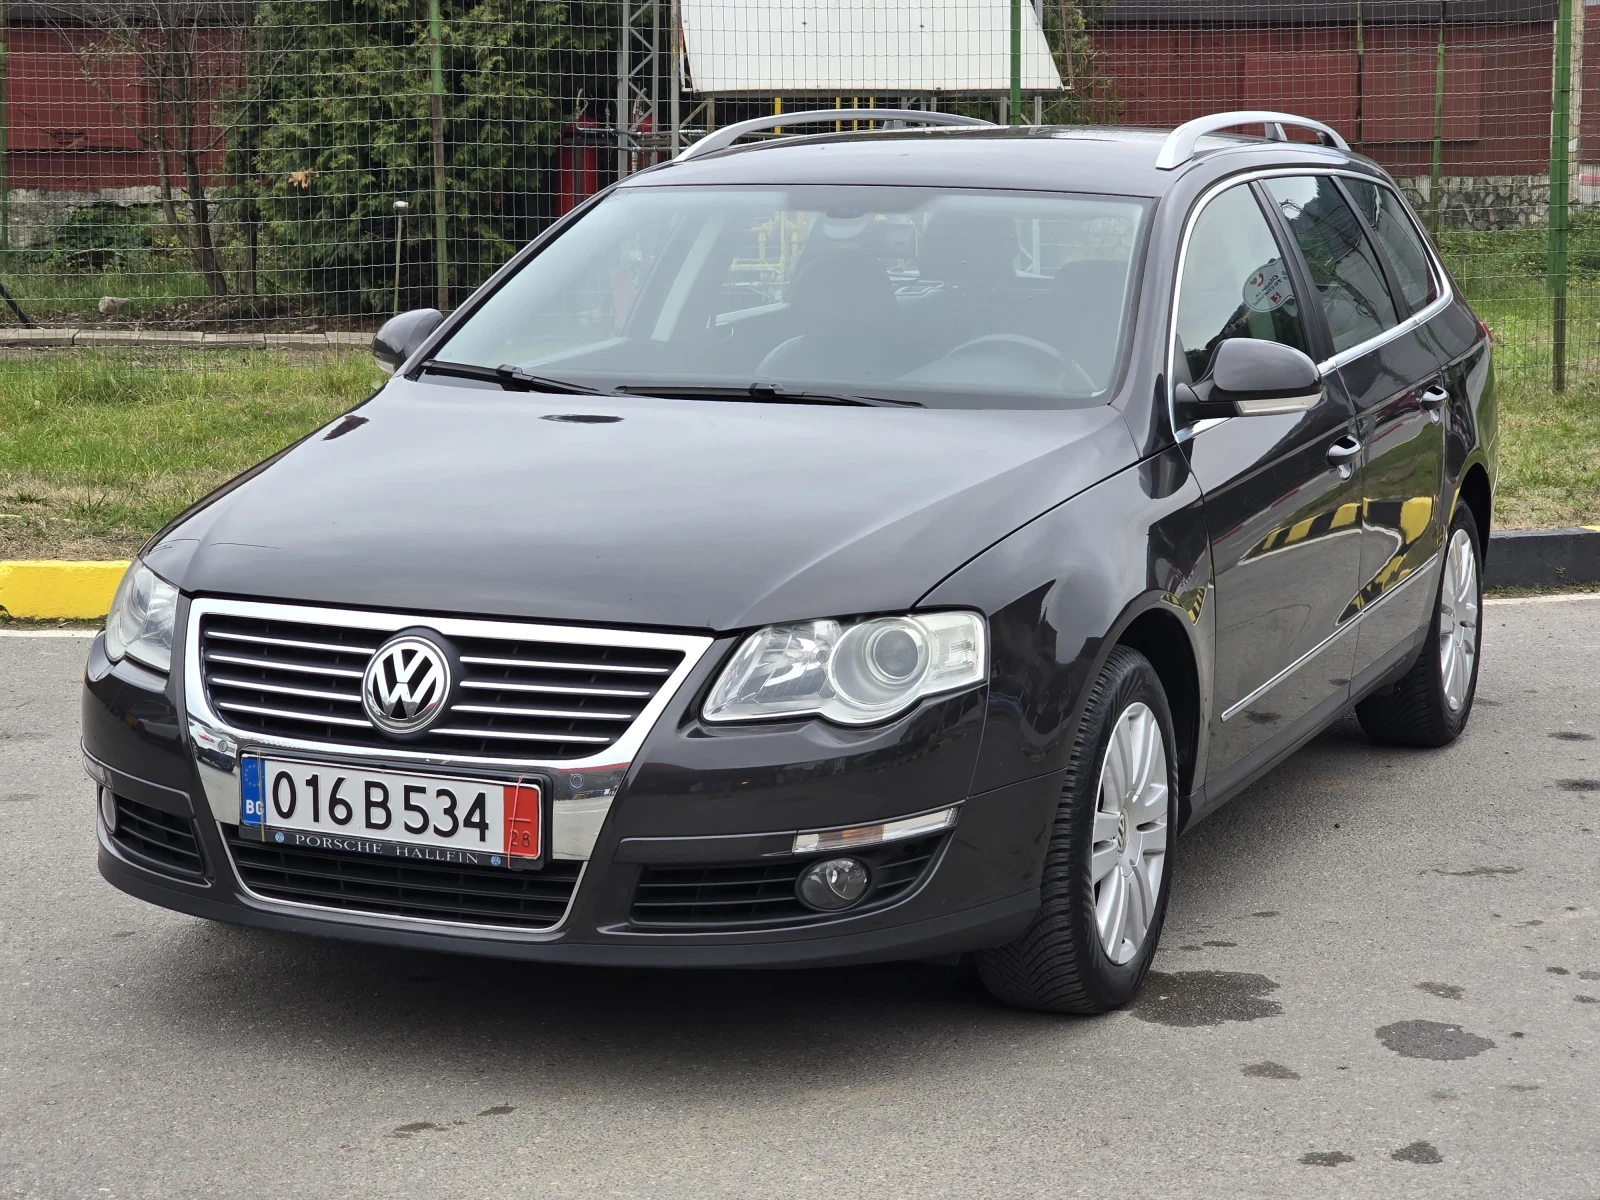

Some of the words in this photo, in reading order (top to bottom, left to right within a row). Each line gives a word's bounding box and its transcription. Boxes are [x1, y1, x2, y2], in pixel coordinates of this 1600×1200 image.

[245, 799, 265, 816] BG
[295, 834, 383, 854] PORSCHE
[396, 846, 478, 864] HALLEIN
